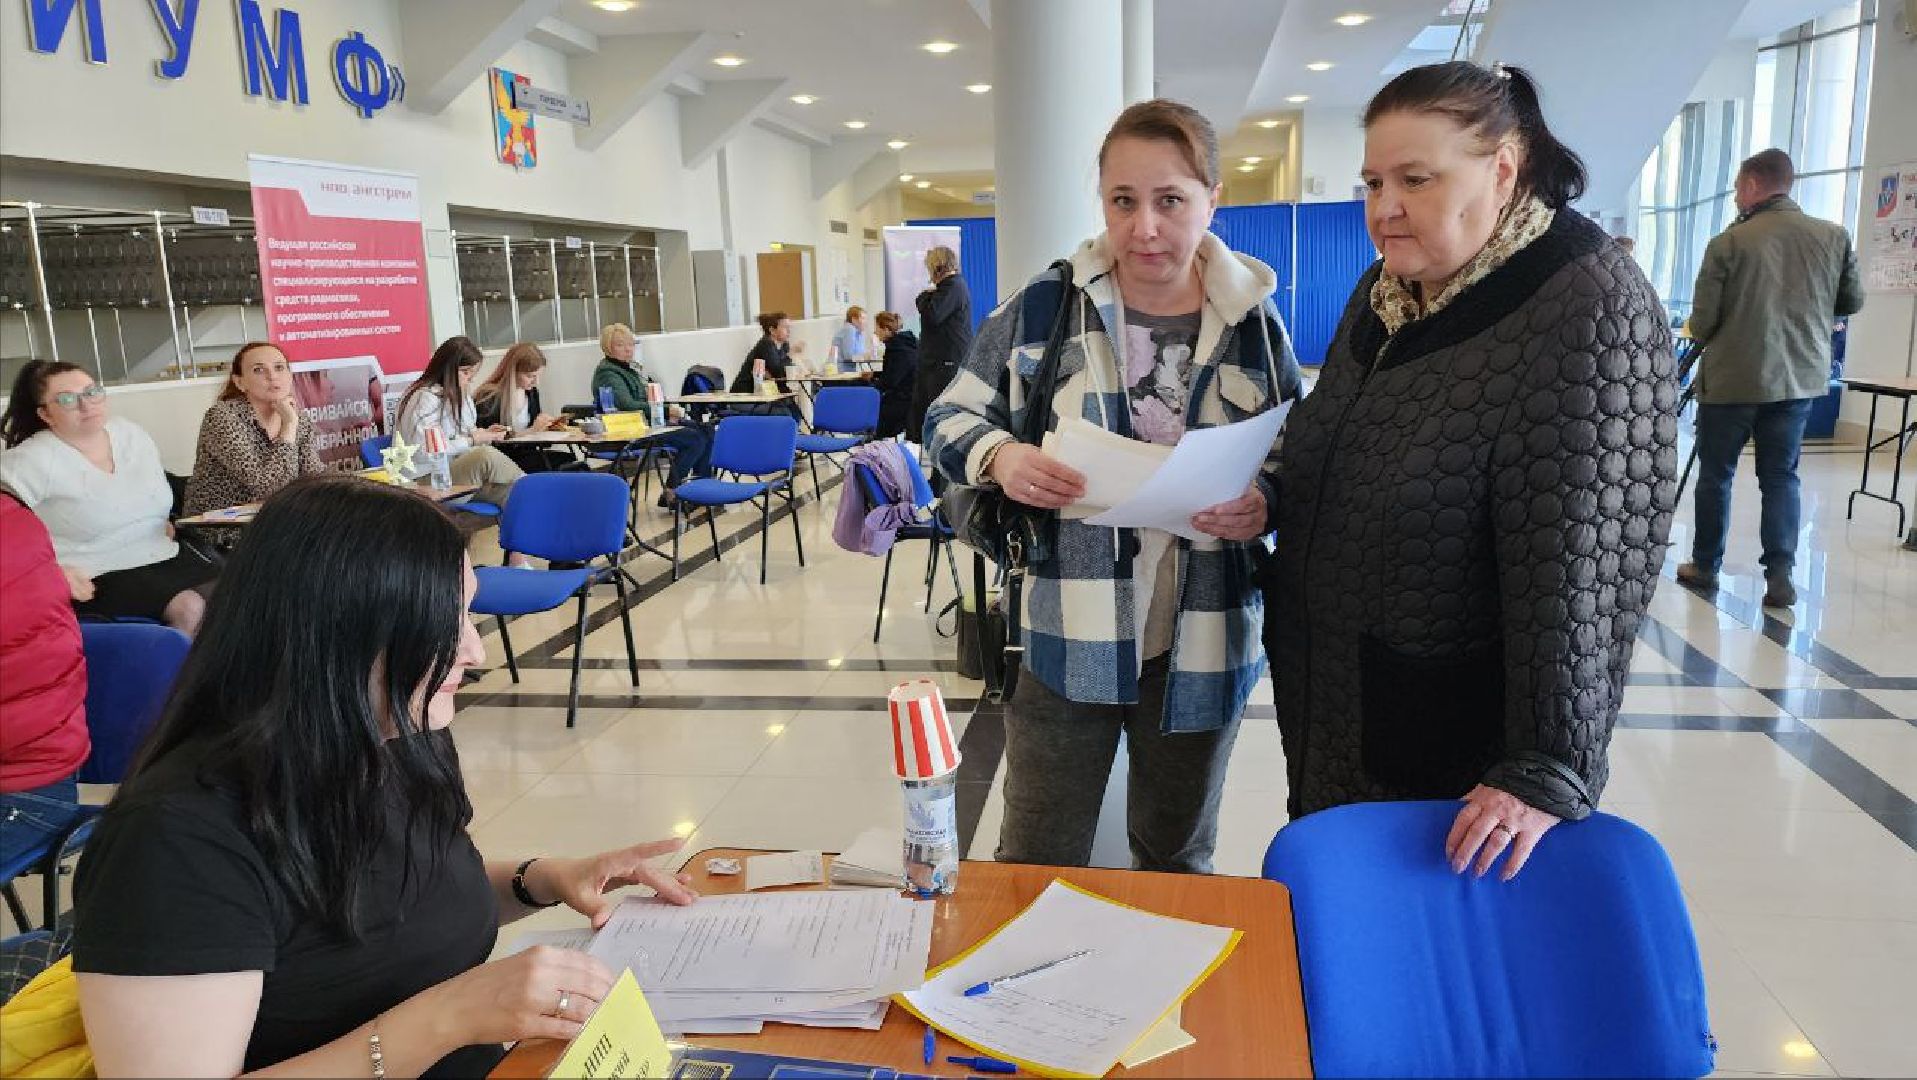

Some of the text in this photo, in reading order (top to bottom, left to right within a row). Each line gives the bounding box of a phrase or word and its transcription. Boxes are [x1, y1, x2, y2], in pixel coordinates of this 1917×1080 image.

[268, 237, 357, 251] Ведущая российская
[271, 258, 380, 270] научно-производственная
[273, 276, 364, 287] специализирующаяся
[365, 277, 375, 285] на
[274, 294, 309, 307] средств
[277, 308, 390, 325] программного обеспечения
[286, 327, 375, 341] автоматизированных
[375, 325, 401, 335] систем
